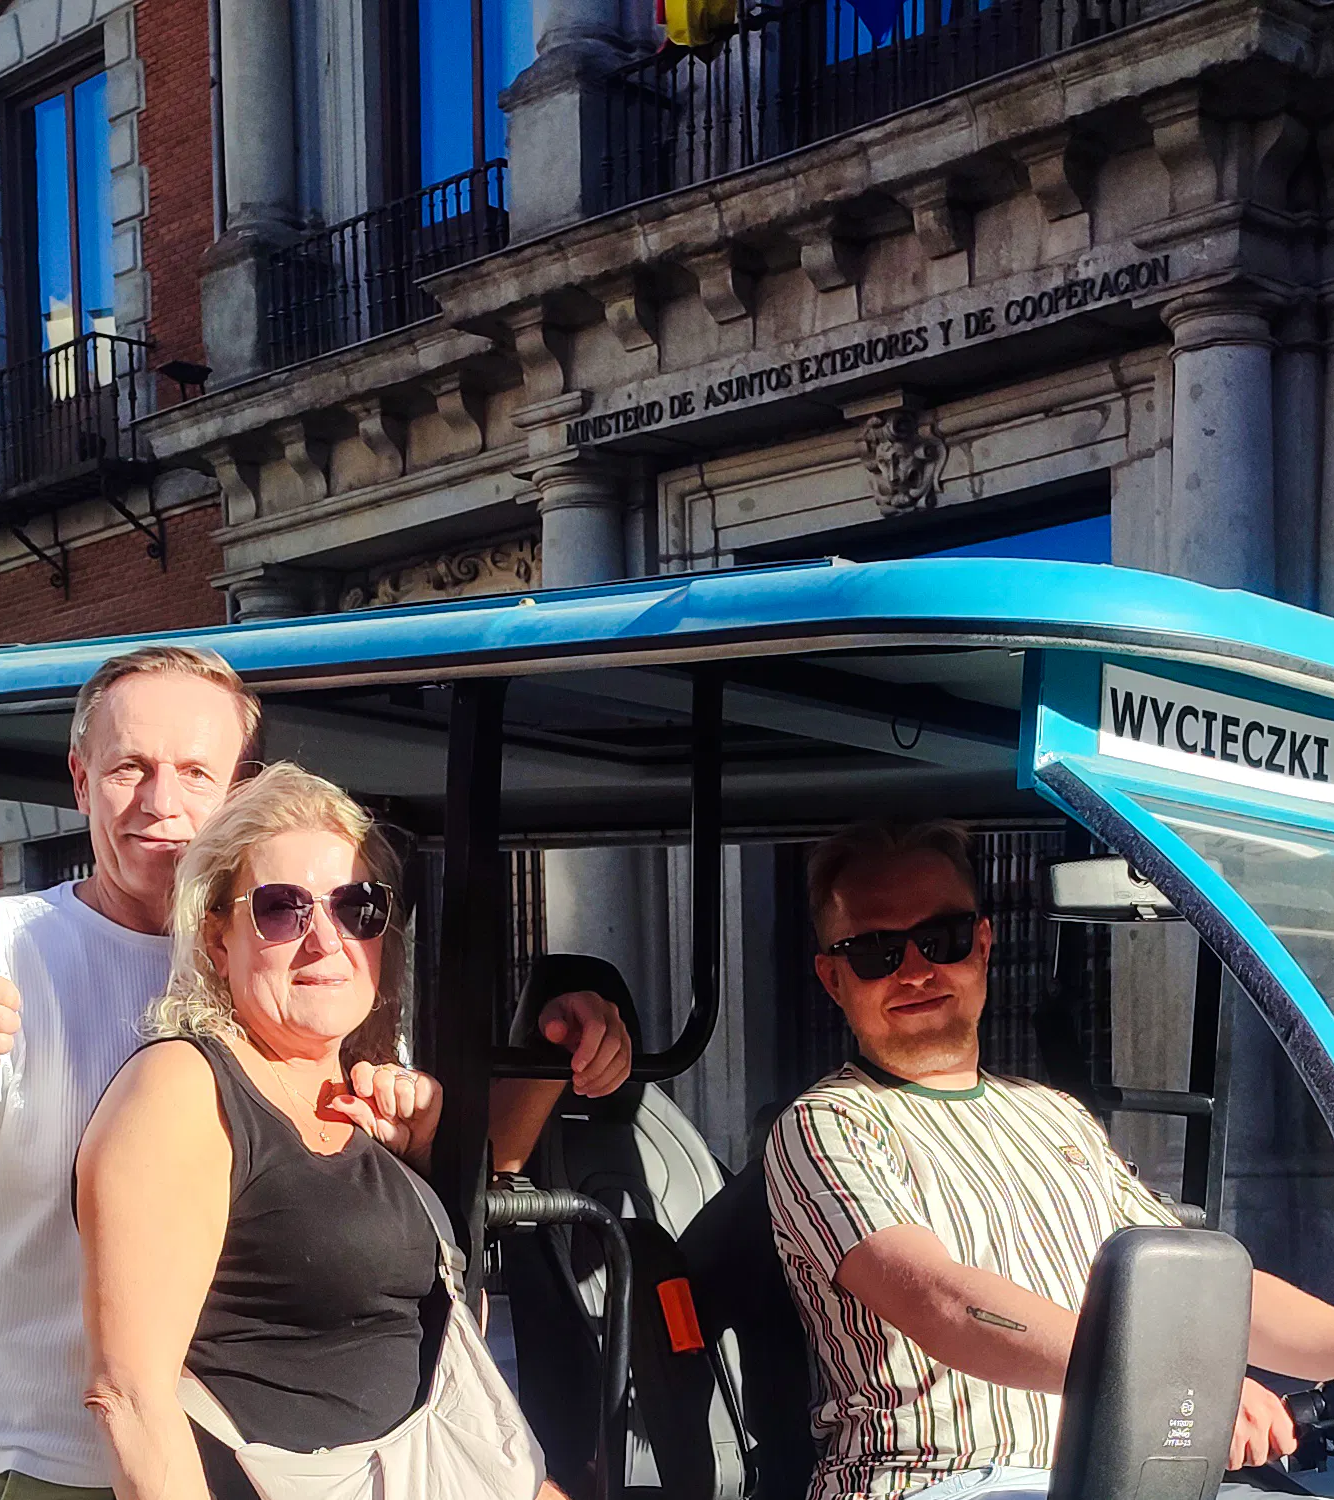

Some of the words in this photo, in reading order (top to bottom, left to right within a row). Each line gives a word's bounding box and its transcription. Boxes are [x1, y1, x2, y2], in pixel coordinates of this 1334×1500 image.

[565, 400, 663, 446] MINISTERIO
[668, 391, 696, 419] DE
[703, 363, 792, 411] ASUNTOS
[799, 326, 928, 385] EXTERIORES
[938, 318, 954, 347] Y
[964, 307, 997, 340] DE
[1004, 254, 1171, 326] COOPERACION
[1110, 686, 1330, 782] WYCIECZKI
